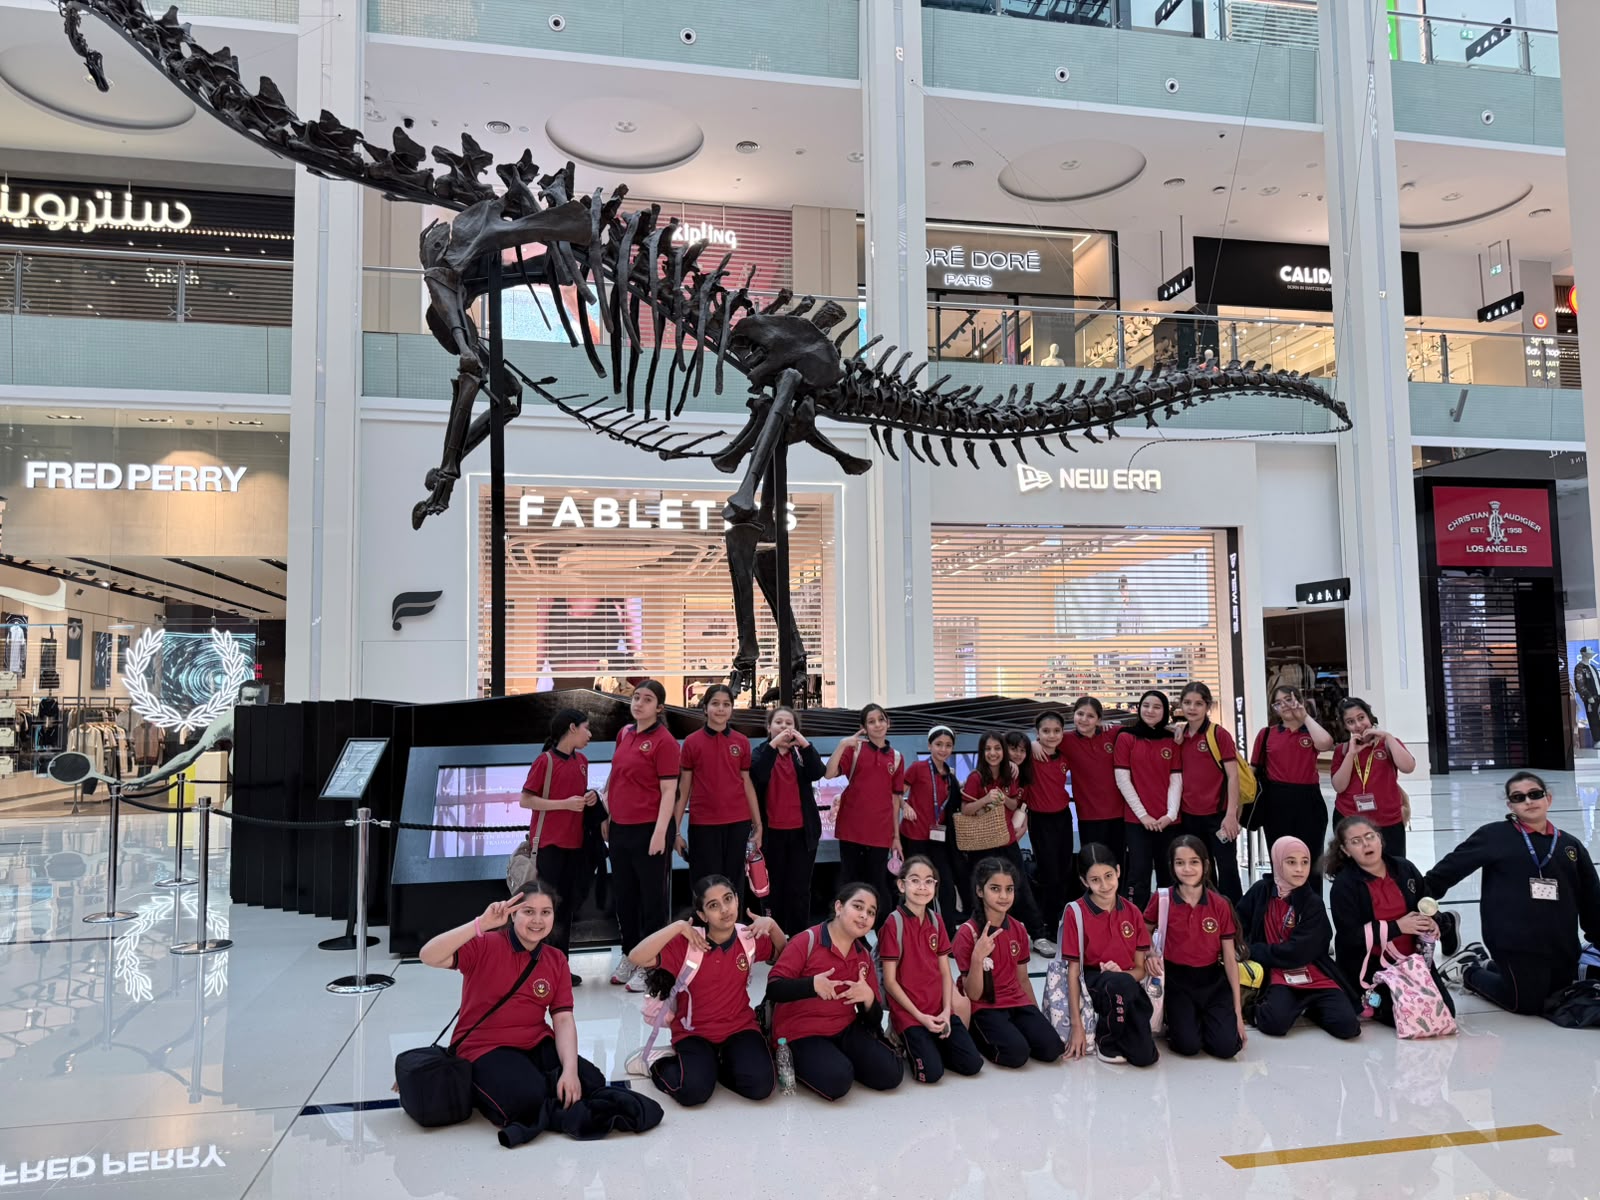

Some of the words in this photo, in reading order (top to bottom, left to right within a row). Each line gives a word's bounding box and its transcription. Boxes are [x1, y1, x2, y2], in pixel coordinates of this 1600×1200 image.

[971, 249, 1042, 273] DORÉ
[943, 273, 993, 289] PARIS
[1279, 265, 1332, 284] CALID
[25, 461, 123, 489] FRED
[128, 464, 248, 493] PERRY
[1060, 467, 1109, 490] NEW
[1113, 469, 1162, 491] ERA
[1447, 511, 1490, 532] CHRISTIAN
[1503, 512, 1542, 533] AUDIGIER
[1470, 526, 1486, 534] EST.
[1466, 544, 1485, 553] LOS
[1486, 545, 1528, 553] ANGELES
